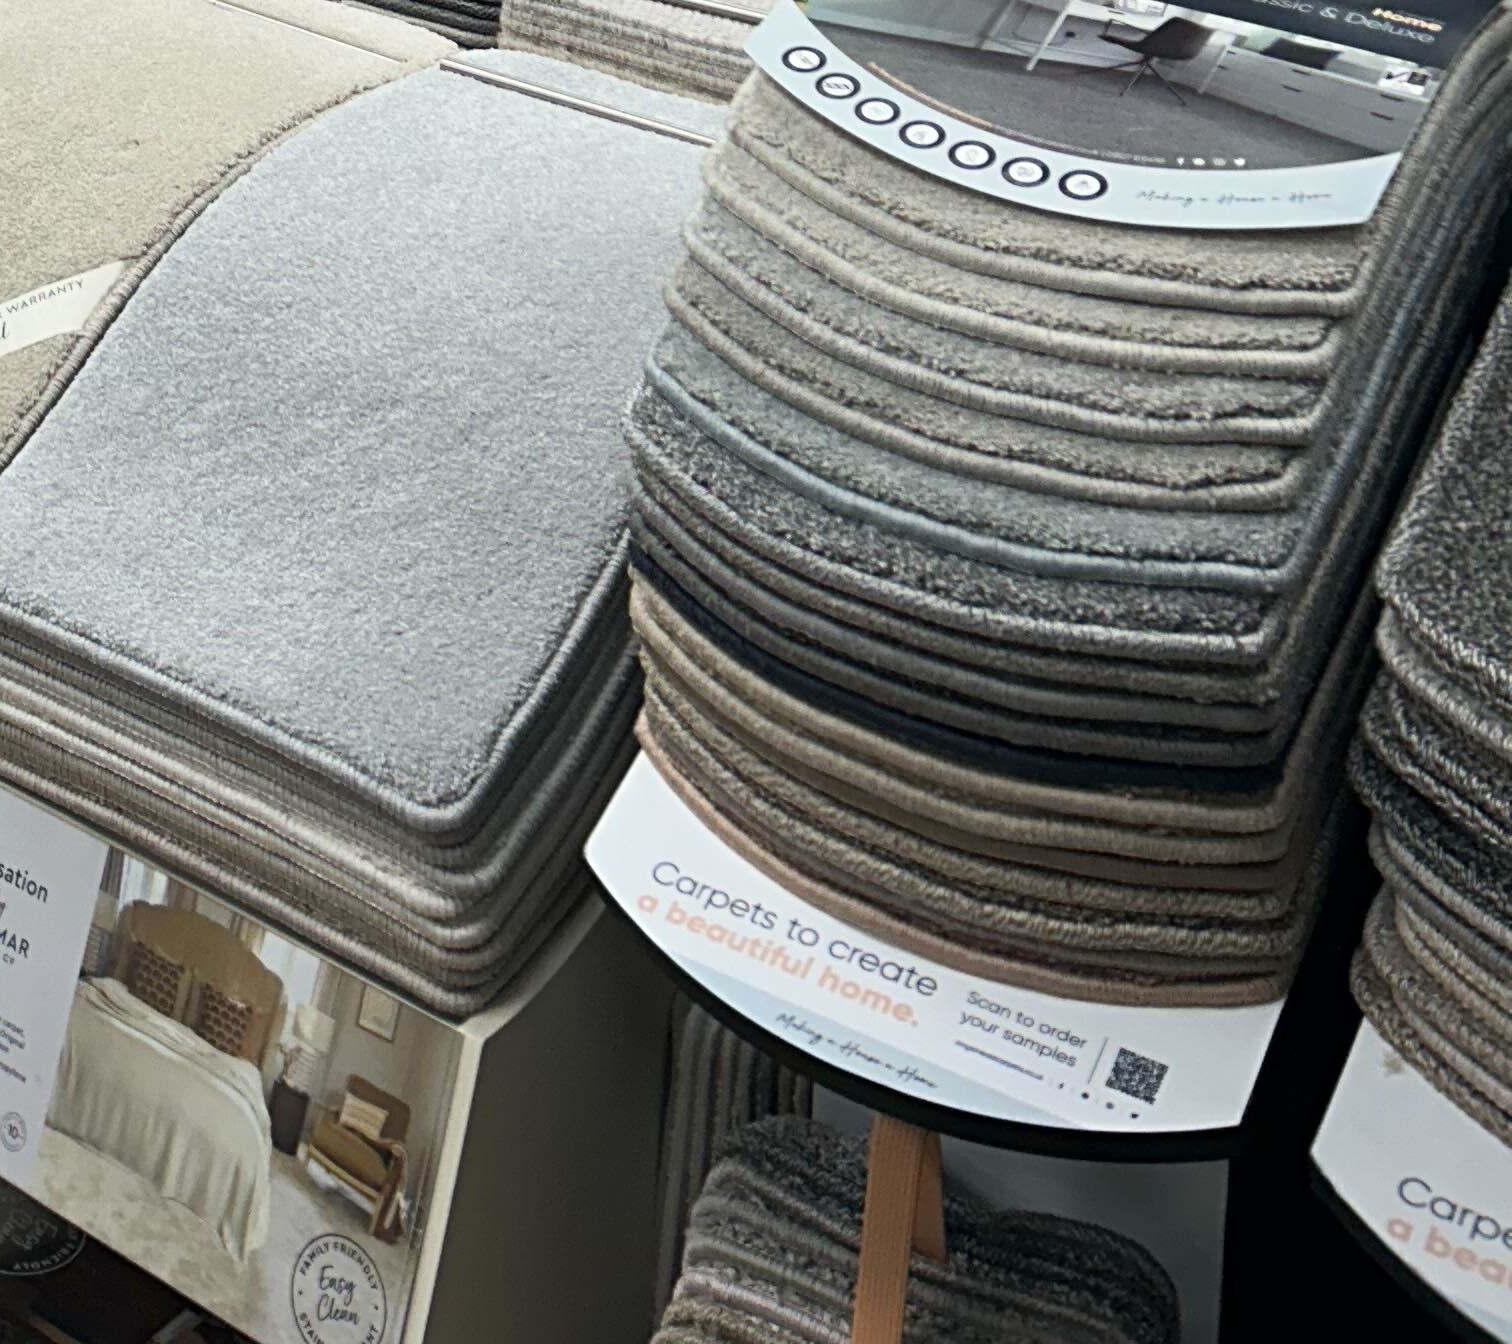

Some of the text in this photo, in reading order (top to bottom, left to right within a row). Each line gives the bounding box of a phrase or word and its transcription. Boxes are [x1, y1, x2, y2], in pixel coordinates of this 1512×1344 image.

[1319, 6, 1338, 21] &
[1344, 10, 1437, 44] Deluxe
[6, 278, 85, 314] WARRANTY
[651, 861, 938, 997] Carpets to create
[636, 894, 919, 1028] a beautiful home.
[776, 1011, 824, 1046] Making
[959, 1010, 999, 1035] your
[1003, 1028, 1078, 1069] samples
[966, 990, 1089, 1049] Scan to order
[7, 1123, 20, 1139] 10
[1387, 1217, 1414, 1243] a
[299, 1241, 379, 1291] FAMILY FRIENDLY
[319, 1264, 356, 1306] Easy
[317, 1293, 360, 1326] Clean
